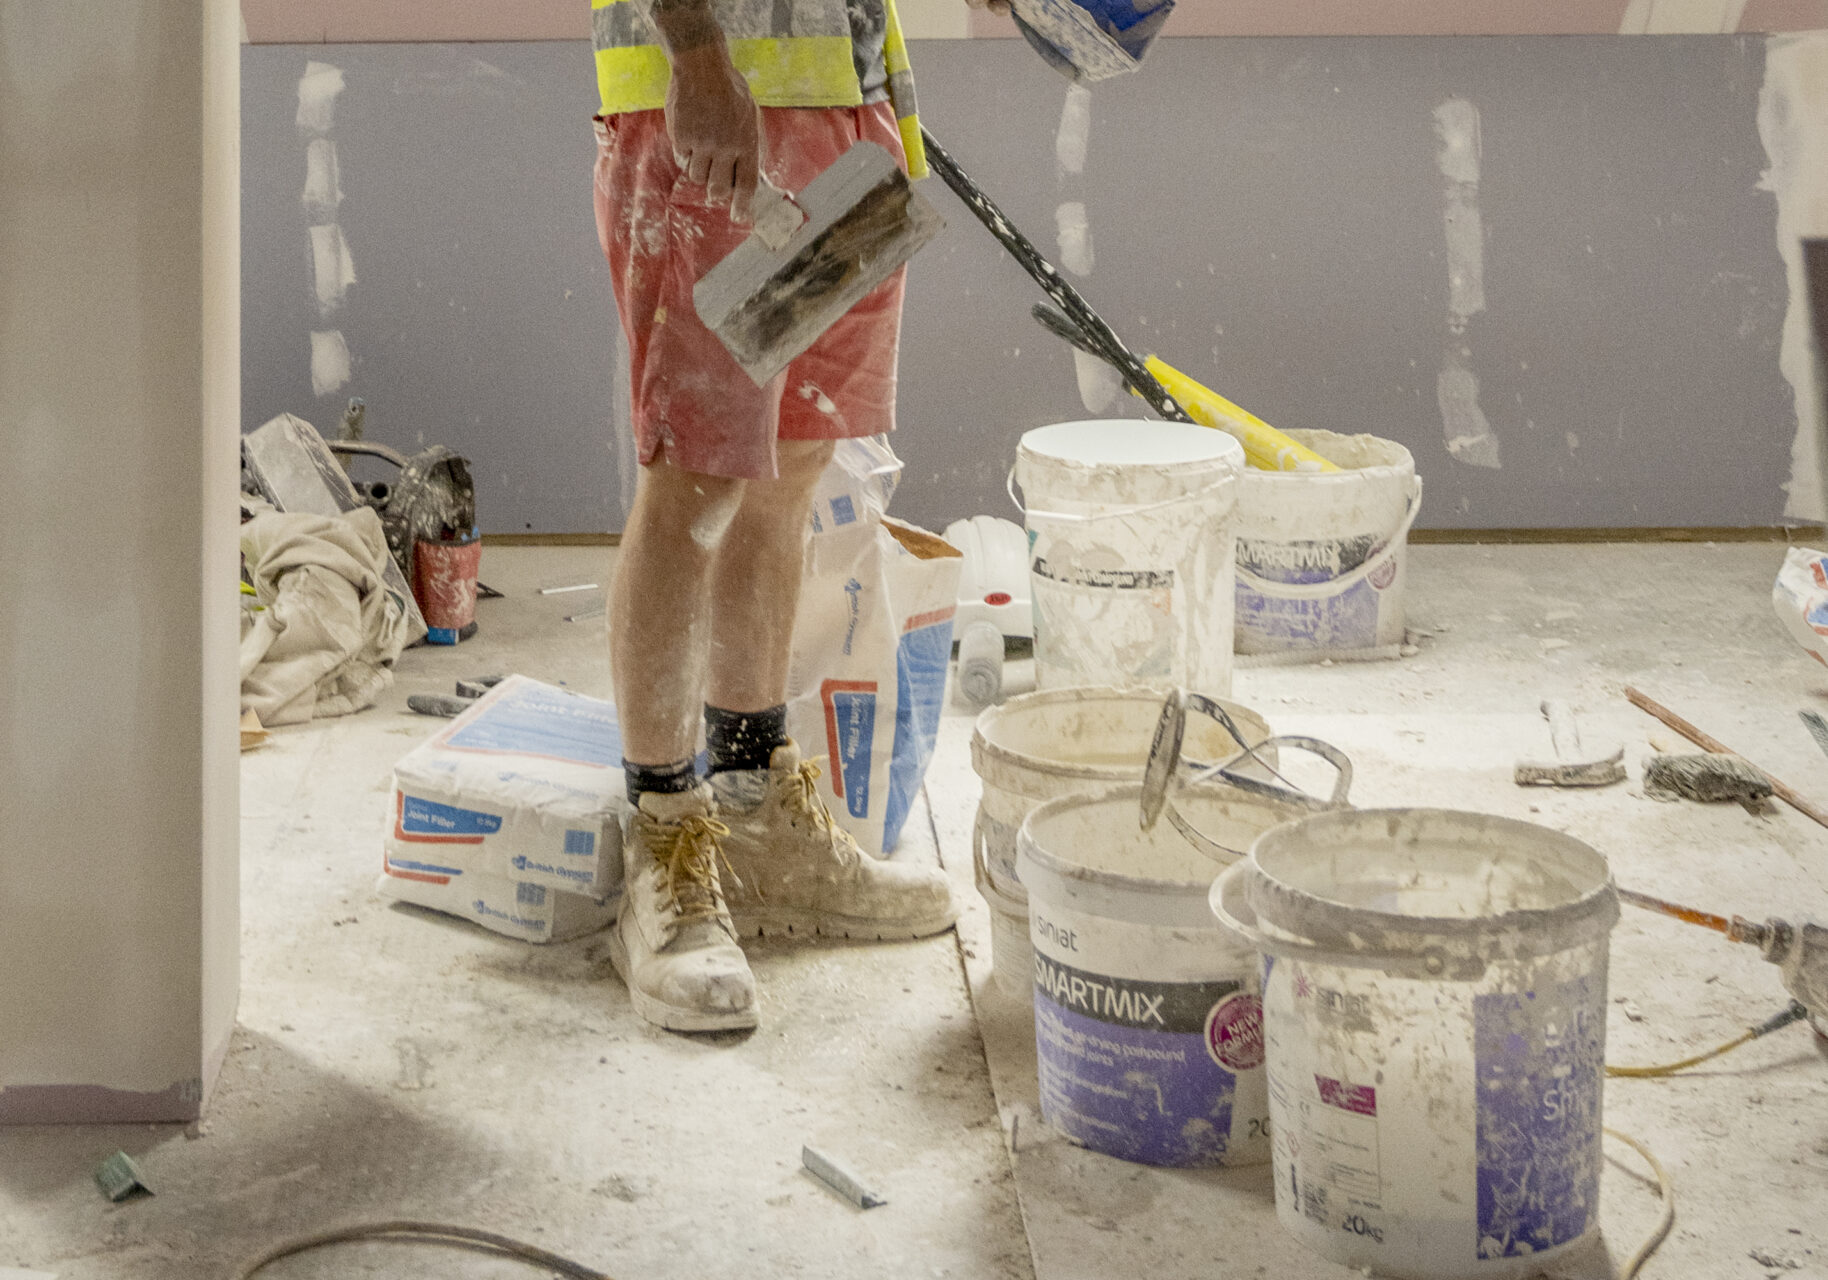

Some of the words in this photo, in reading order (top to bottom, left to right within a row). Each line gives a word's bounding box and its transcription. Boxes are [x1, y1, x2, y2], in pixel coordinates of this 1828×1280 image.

[851, 696, 863, 726] Joint
[846, 727, 860, 759] Filler
[407, 810, 430, 825] Joint
[430, 814, 457, 830] Filler
[1037, 915, 1079, 953] siniat
[1035, 953, 1164, 1025] SMARTMIX
